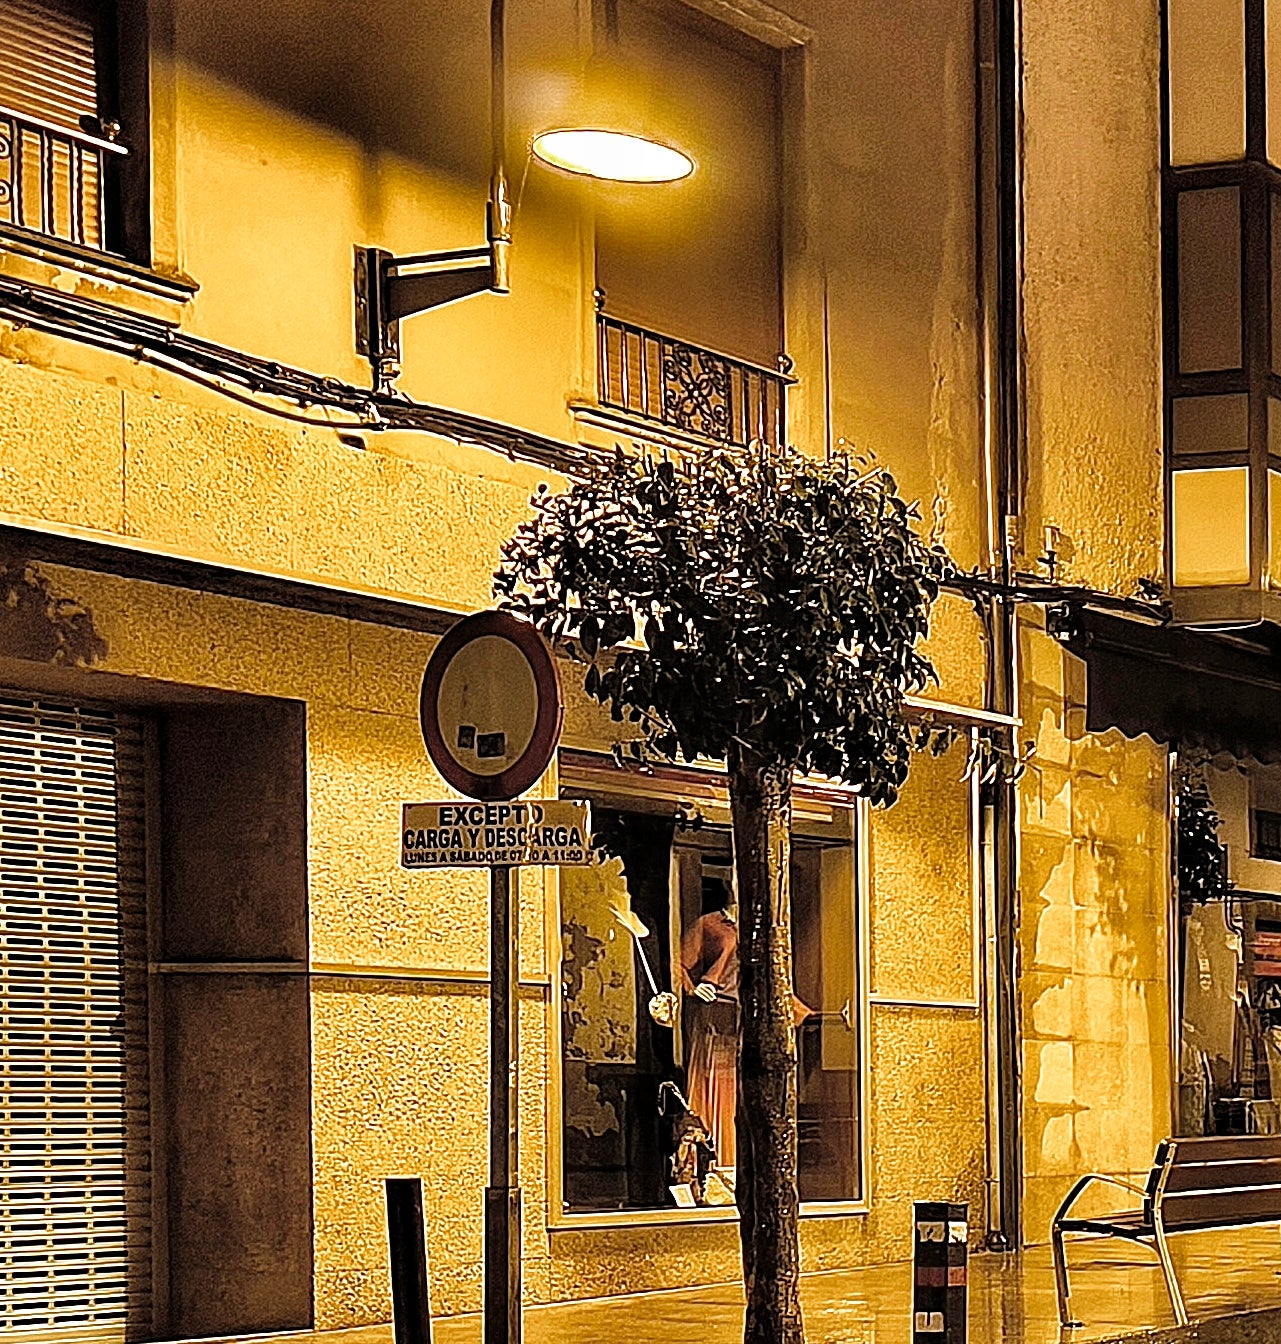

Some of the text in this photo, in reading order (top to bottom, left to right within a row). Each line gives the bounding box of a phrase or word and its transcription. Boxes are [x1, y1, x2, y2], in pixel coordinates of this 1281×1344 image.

[439, 804, 544, 827] EXCEPTO
[404, 826, 582, 850] CARGA Y DESCARGA
[405, 850, 437, 864] LUNES
[439, 850, 447, 863] A
[510, 849, 541, 863] 070
[542, 849, 551, 862] A
